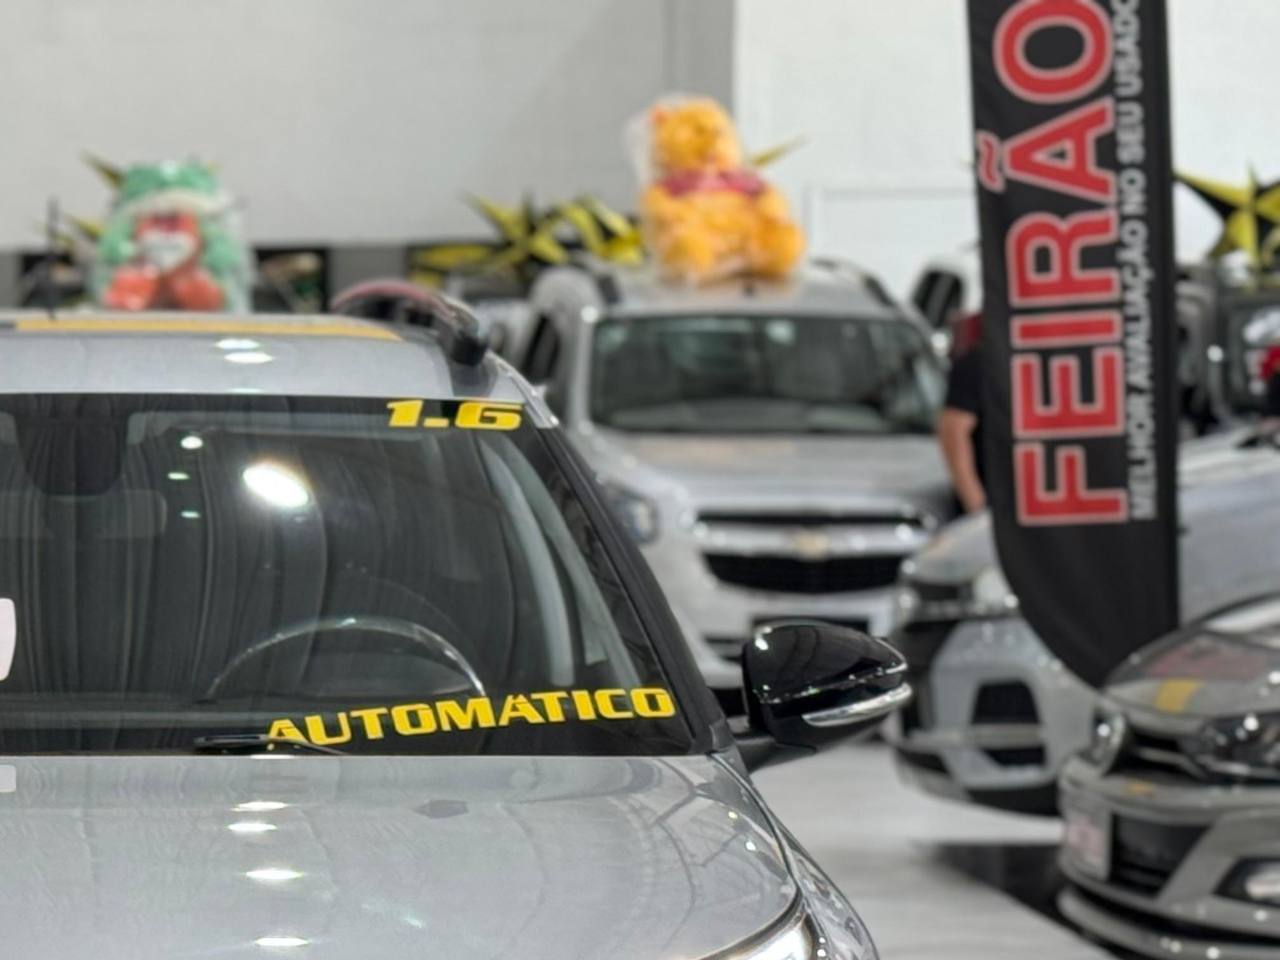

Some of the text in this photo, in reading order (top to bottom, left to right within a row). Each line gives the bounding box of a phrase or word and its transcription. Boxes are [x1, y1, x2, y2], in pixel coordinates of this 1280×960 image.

[1116, 101, 1145, 164] SEU
[1119, 167, 1147, 216] NO
[976, 0, 1129, 526] FEIRÃO
[1117, 220, 1155, 389] AVALIAÇÃO
[386, 399, 524, 431] 1.6
[1125, 393, 1158, 520] MELHOR
